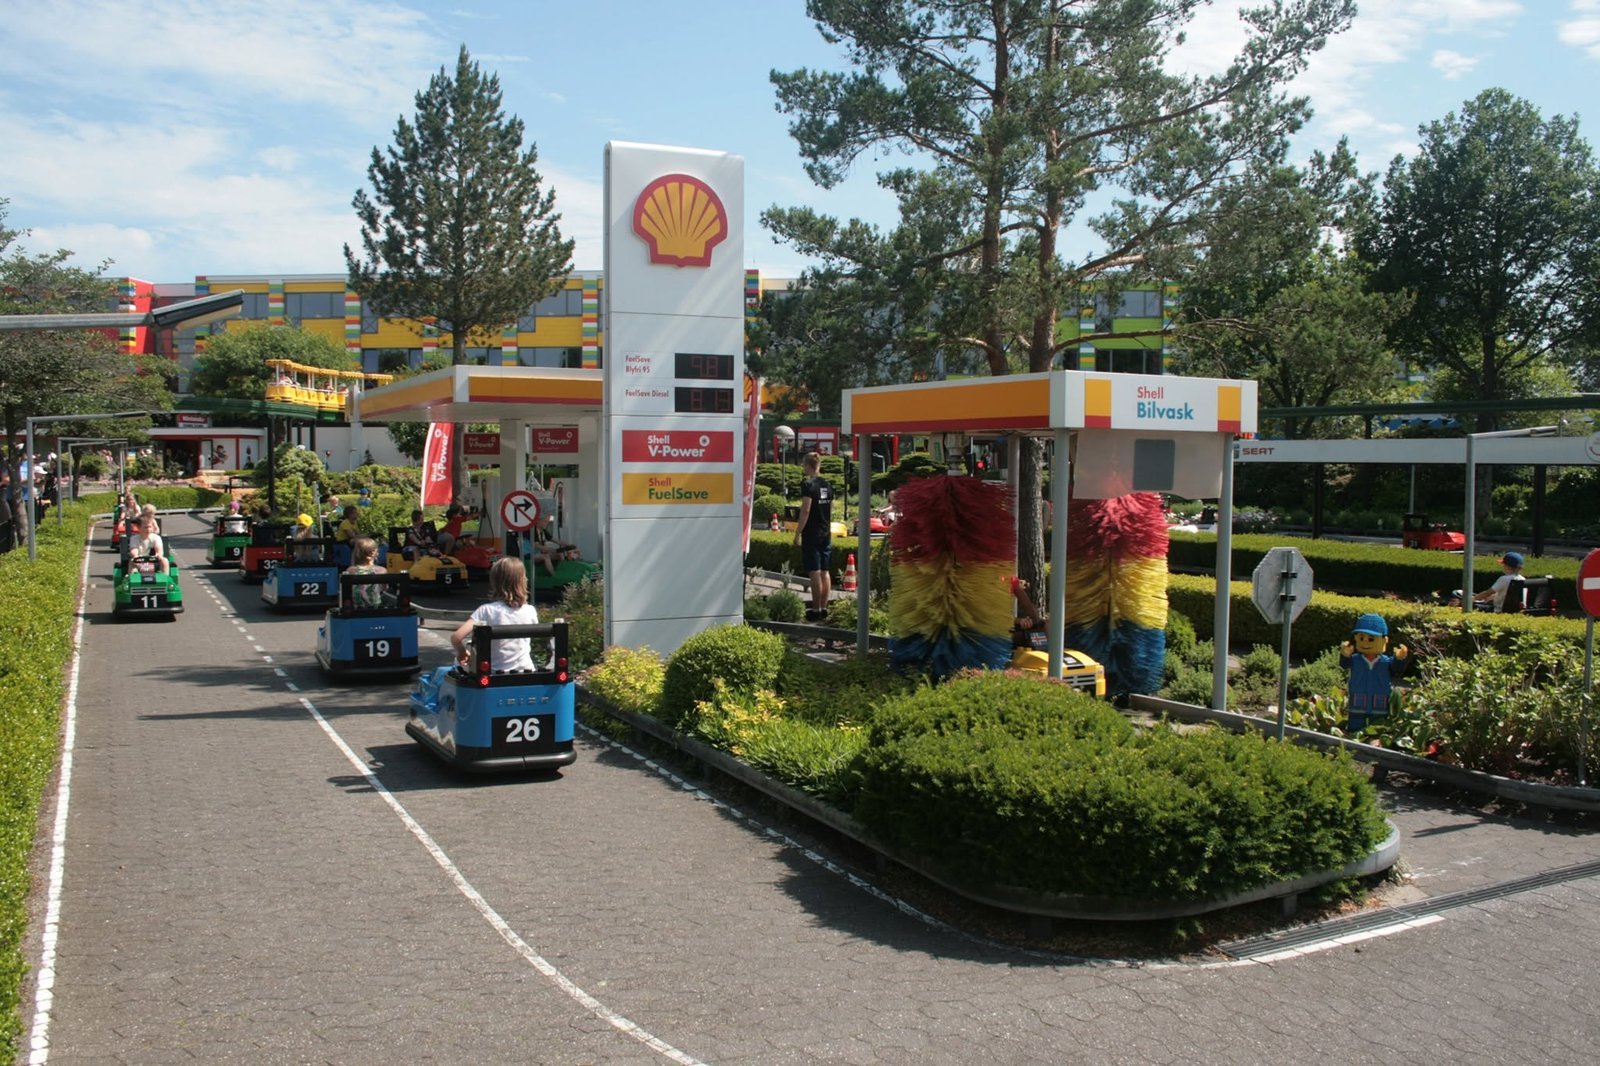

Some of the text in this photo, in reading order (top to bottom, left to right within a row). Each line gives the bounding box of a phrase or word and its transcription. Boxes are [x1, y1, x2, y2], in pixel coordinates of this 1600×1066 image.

[625, 354, 651, 363] FuelSave
[625, 365, 642, 375] Blyfri
[625, 389, 669, 398] FuelSave Diesel
[1137, 386, 1164, 399] Shell
[1137, 401, 1194, 420] Bilvask
[538, 438, 570, 446] V-Power
[647, 435, 670, 444] Shell
[647, 445, 705, 457] V-Power
[1242, 447, 1275, 455] SEAT
[436, 434, 448, 482] V-Power
[648, 477, 672, 487] Shell
[648, 487, 709, 500] FuelSave
[233, 547, 241, 556] 9
[444, 573, 452, 584] 5
[301, 583, 319, 595] 22
[141, 595, 158, 608] 11
[365, 640, 390, 657] 19
[505, 717, 541, 743] 26
